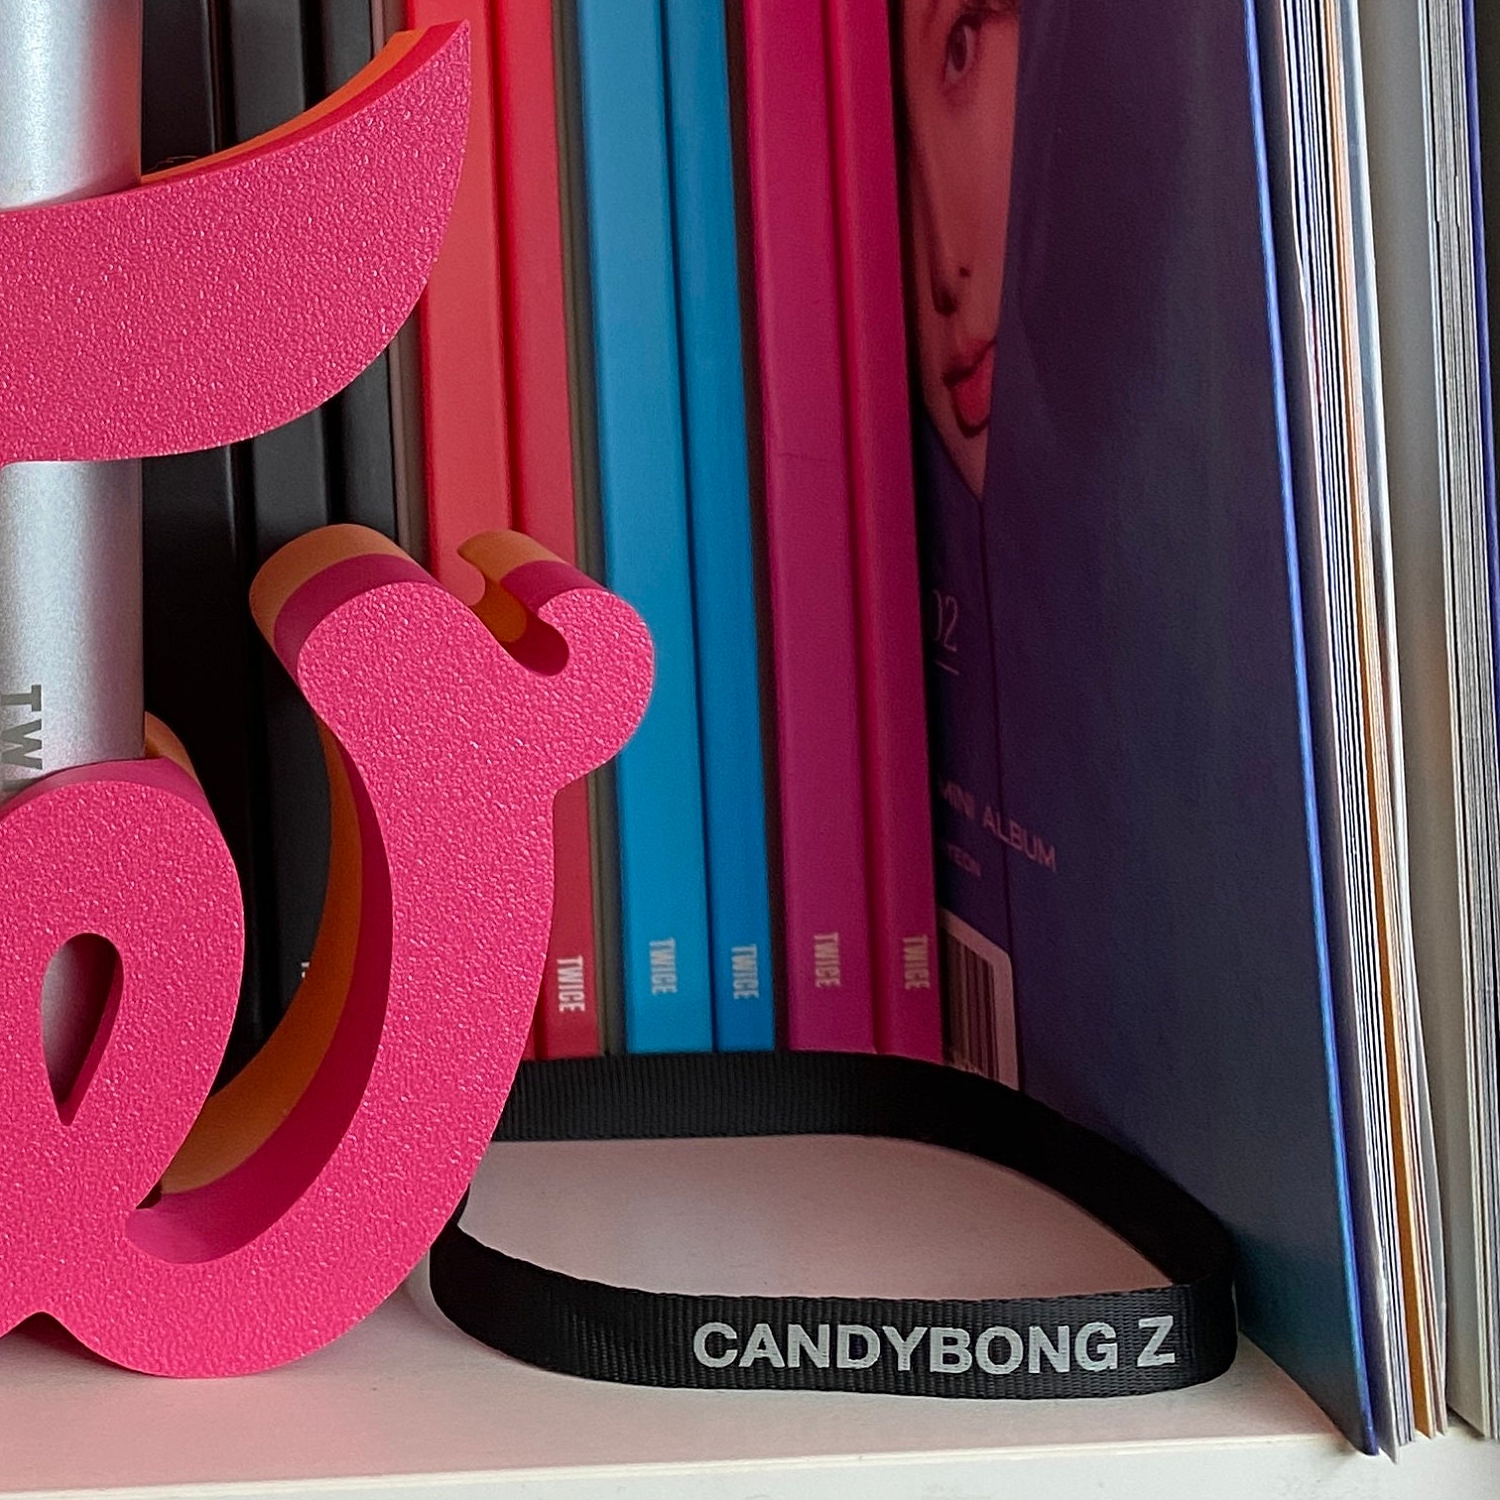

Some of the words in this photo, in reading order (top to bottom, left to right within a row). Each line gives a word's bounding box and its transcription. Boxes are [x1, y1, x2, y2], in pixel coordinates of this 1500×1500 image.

[983, 805, 1057, 874] ALBUM
[556, 955, 586, 1013] TWICE
[649, 937, 678, 995] TWICE
[731, 943, 760, 1000] TWICE
[813, 932, 842, 989] TWICE
[903, 934, 931, 990] TWICE
[693, 1320, 1119, 1375] CANDYBONG
[1137, 1314, 1177, 1368] Z
